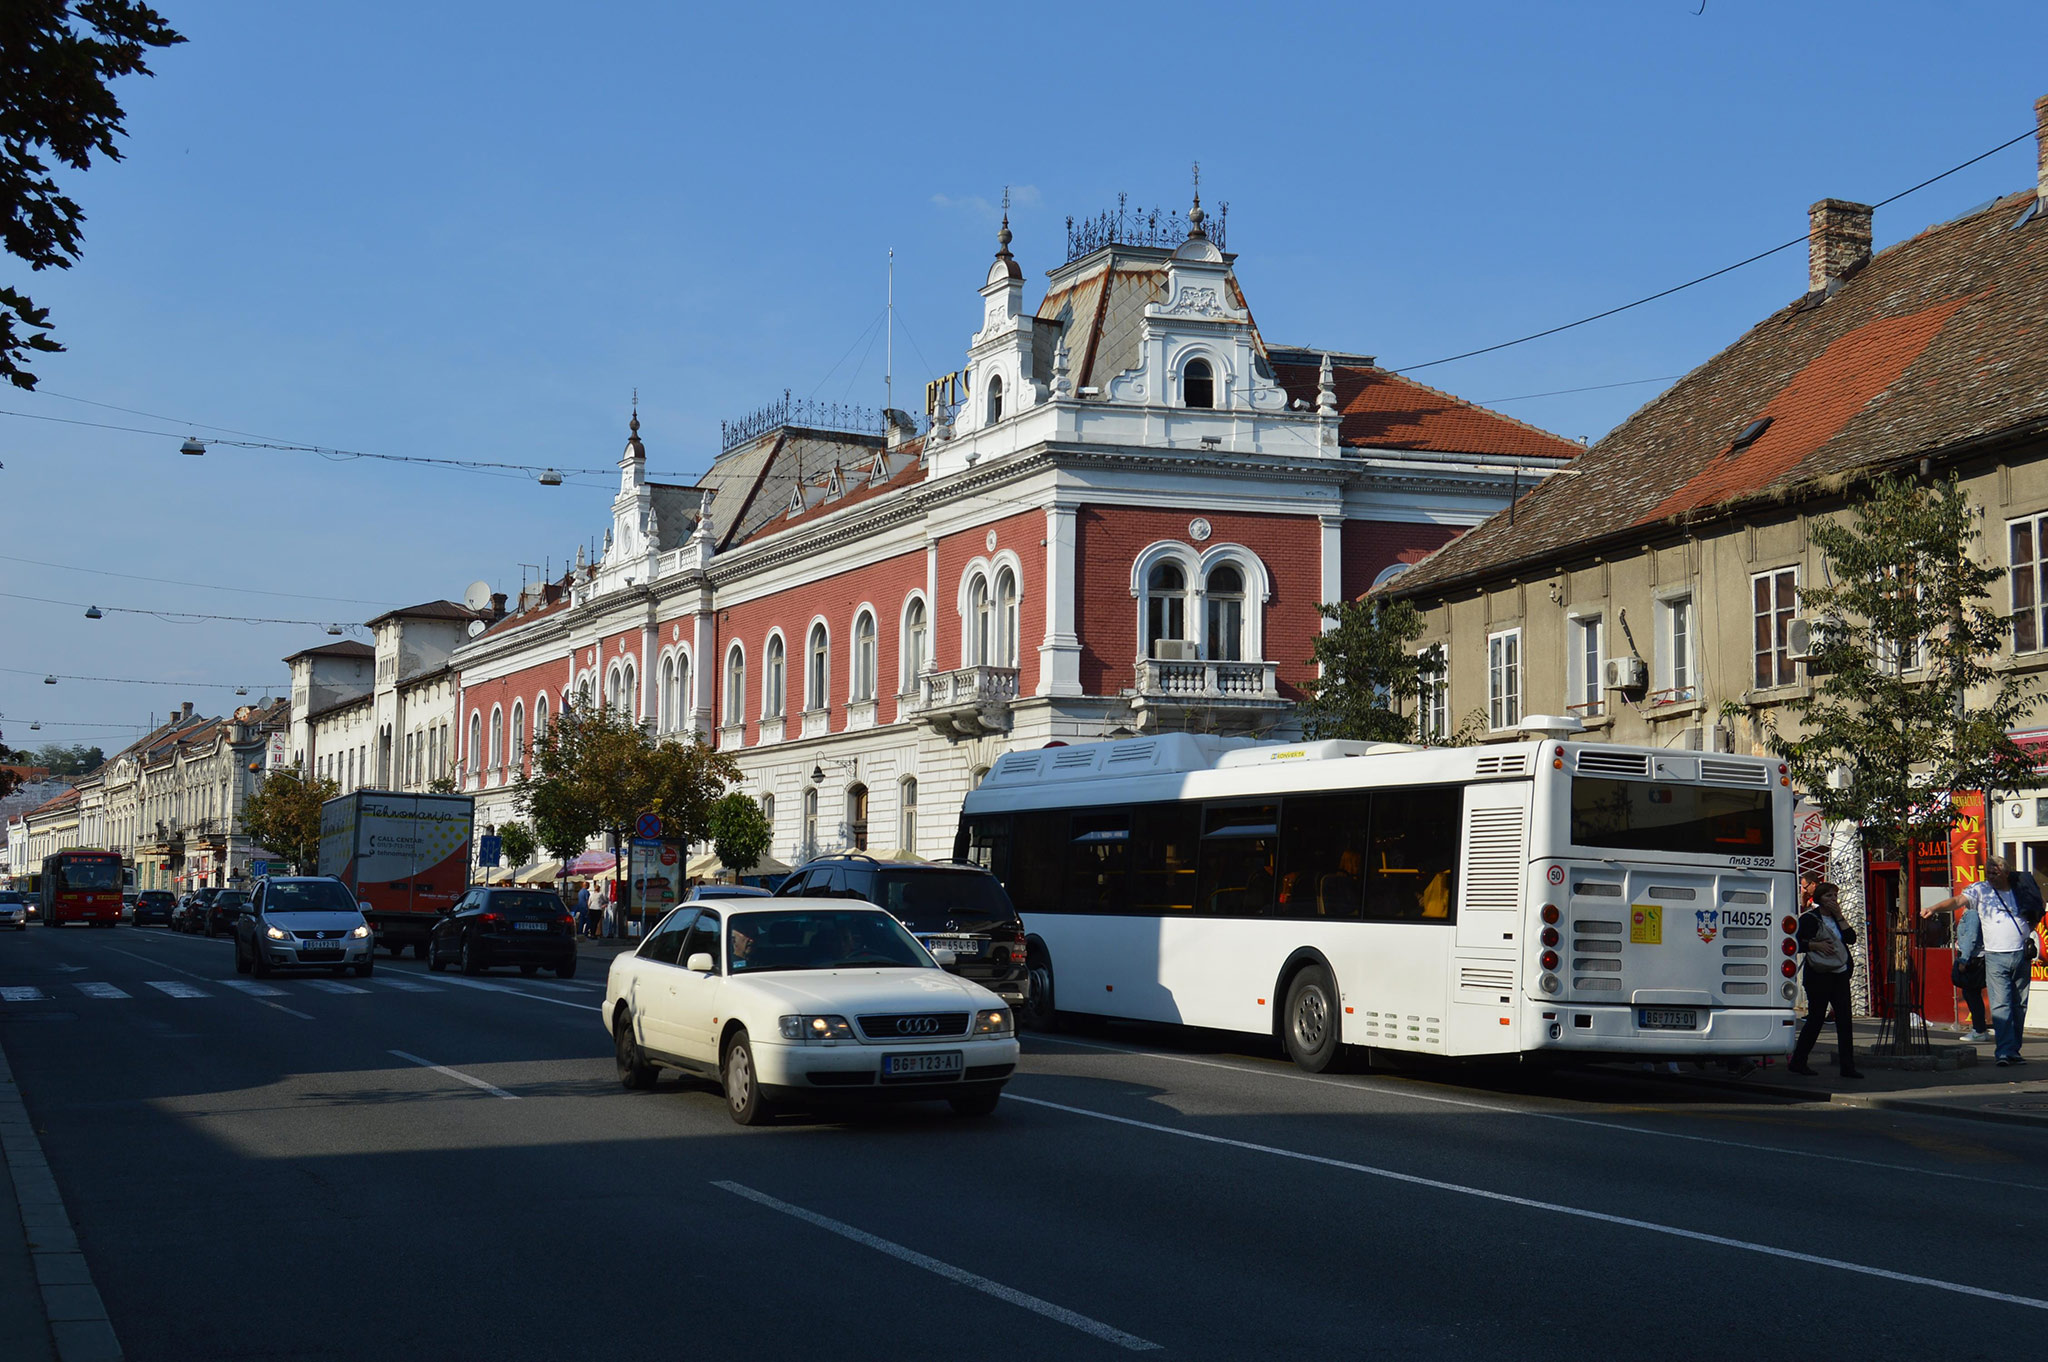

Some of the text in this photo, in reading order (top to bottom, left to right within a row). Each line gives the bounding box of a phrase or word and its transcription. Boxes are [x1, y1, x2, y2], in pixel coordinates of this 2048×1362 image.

[365, 804, 454, 824] Tehnomanija
[1753, 858, 1776, 867] 5292
[1551, 870, 1561, 880] 50
[1722, 910, 1772, 926] П40525
[930, 940, 943, 950] BG
[1647, 1012, 1658, 1023] BG
[893, 1058, 909, 1071] BG
